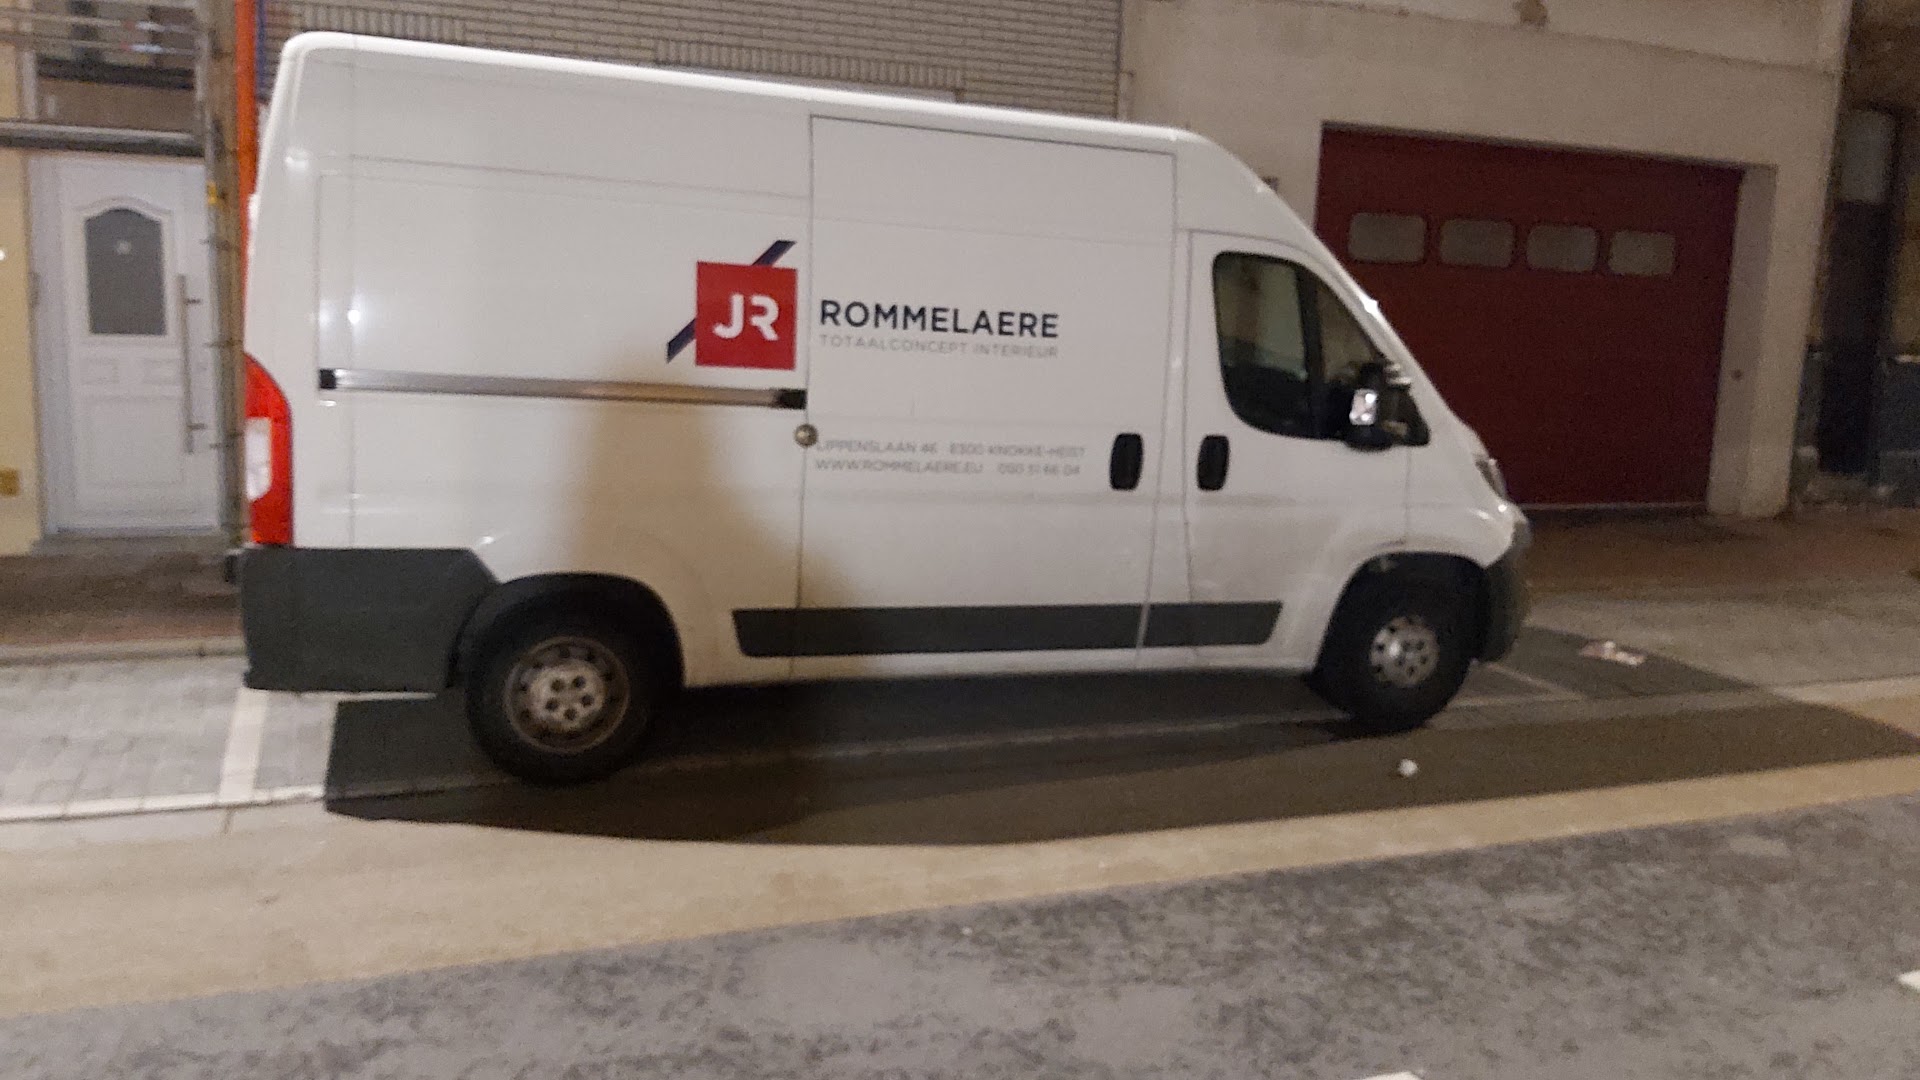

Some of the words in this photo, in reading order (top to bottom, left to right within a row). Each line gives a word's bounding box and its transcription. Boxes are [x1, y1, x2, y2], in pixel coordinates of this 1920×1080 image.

[712, 292, 781, 341] JR
[820, 299, 1060, 339] ROMMELAERE
[819, 334, 969, 354] TOTAALCONCEPT
[974, 343, 1059, 359] INTERIEUR
